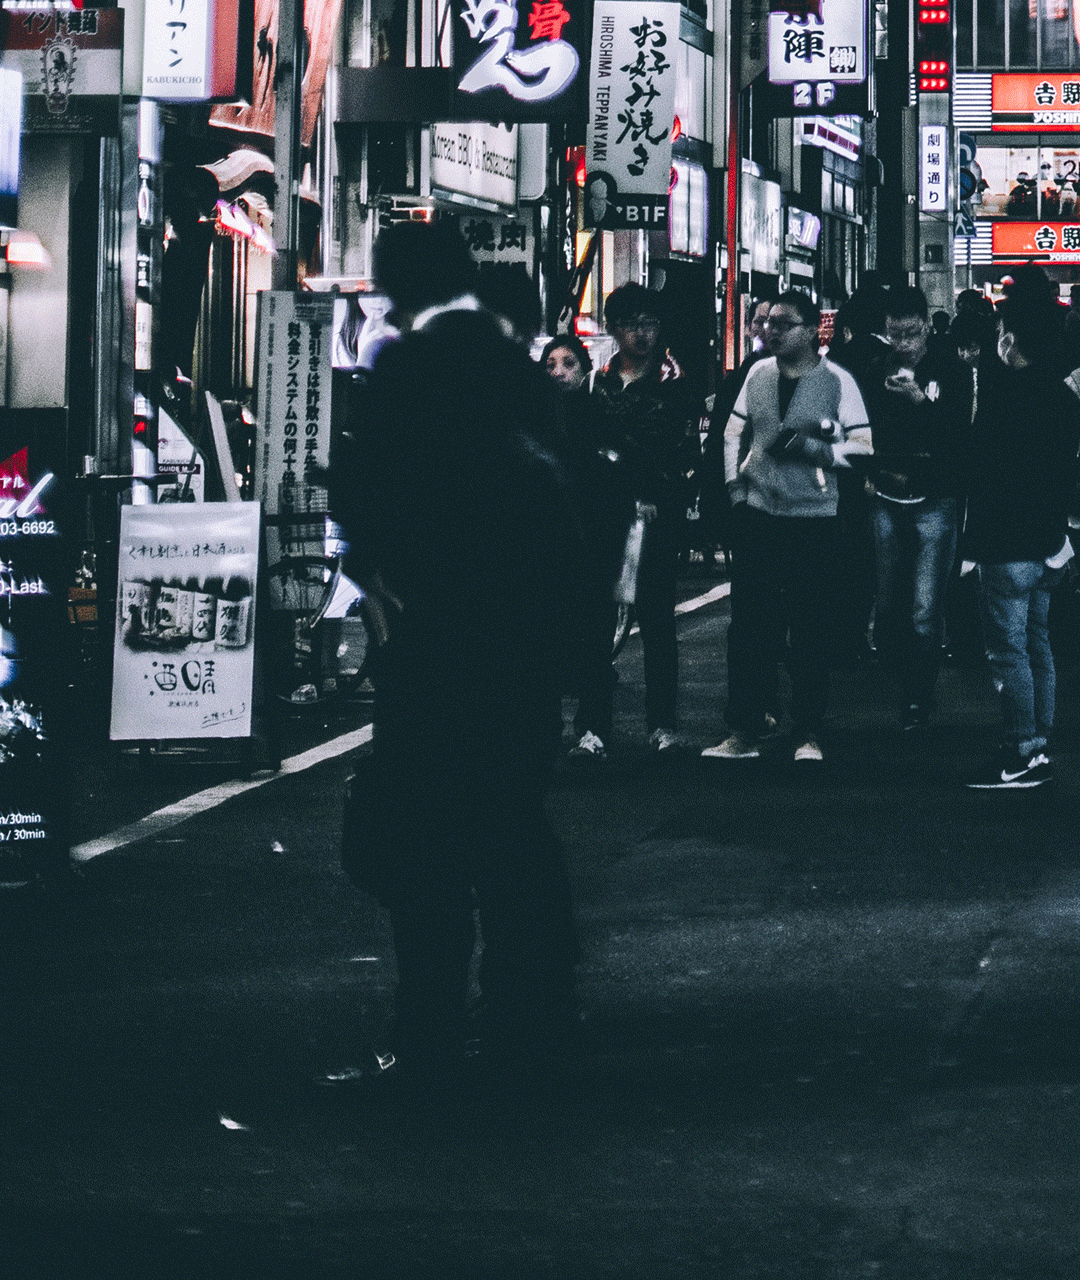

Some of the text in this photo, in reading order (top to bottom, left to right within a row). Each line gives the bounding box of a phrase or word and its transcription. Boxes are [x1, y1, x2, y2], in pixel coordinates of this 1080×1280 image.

[601, 16, 615, 78] HIROSHIMA
[147, 77, 202, 85] KABUKICHO
[618, 15, 671, 177] お好み焼き
[793, 82, 835, 107] 2F
[927, 133, 941, 204] 劇場通り
[626, 205, 666, 222] B1F
